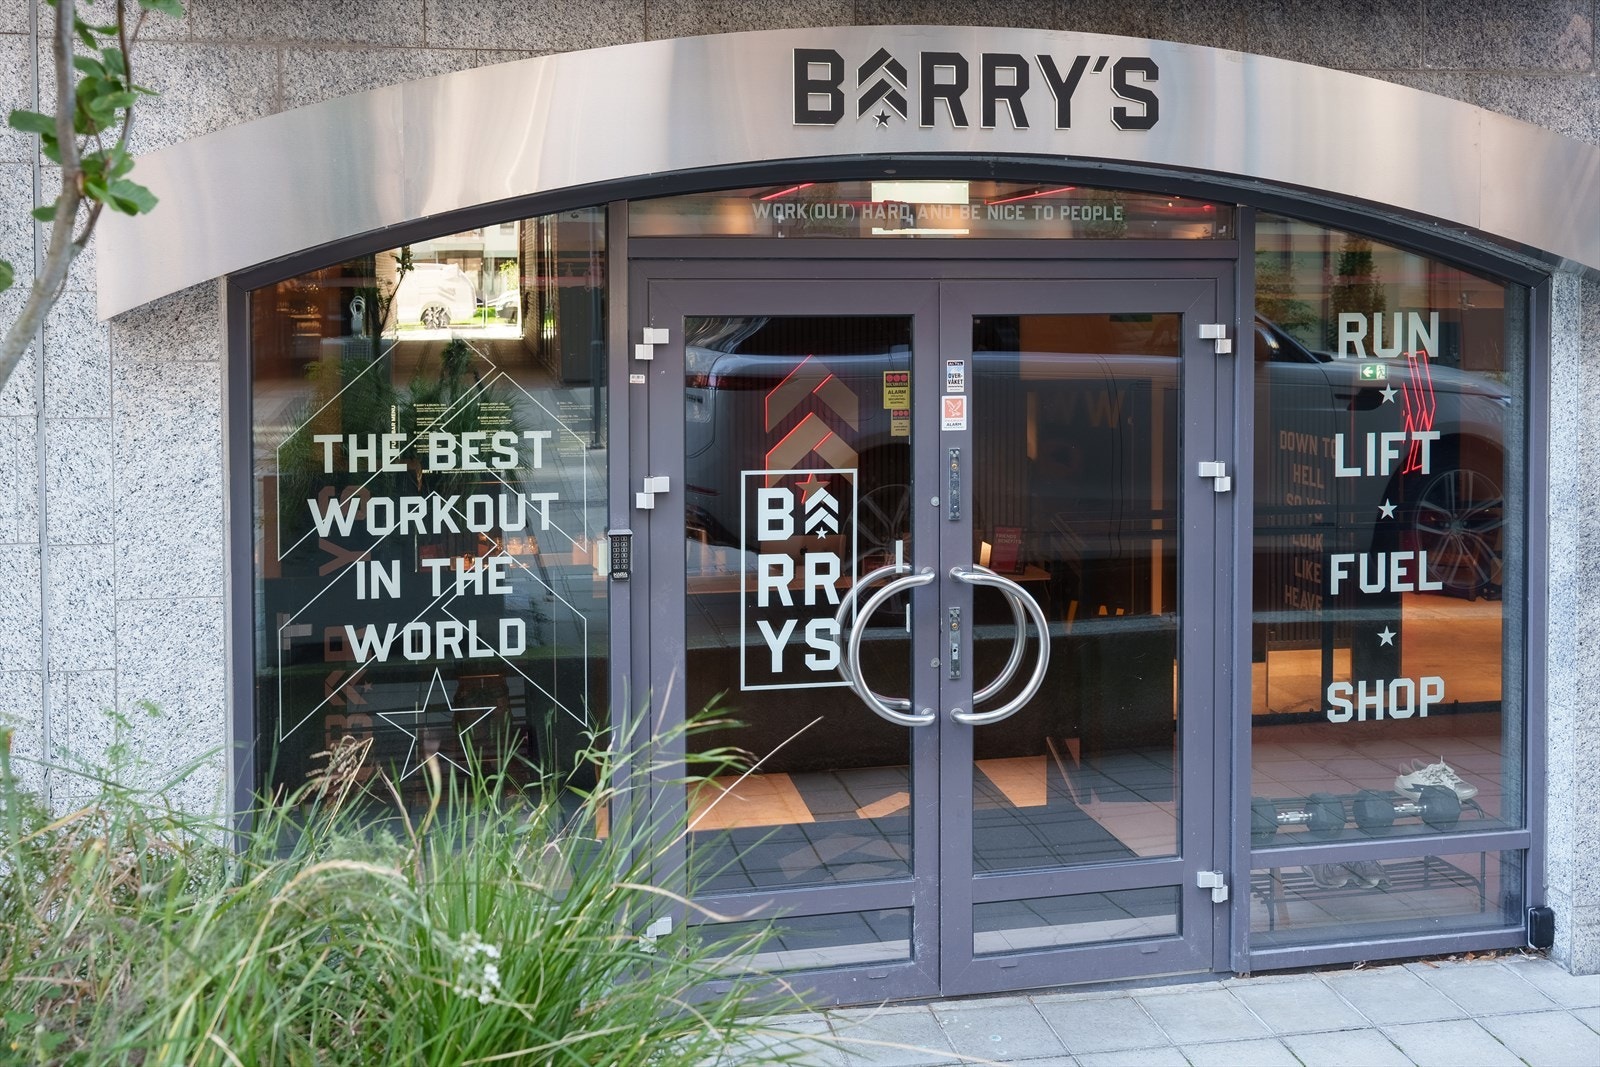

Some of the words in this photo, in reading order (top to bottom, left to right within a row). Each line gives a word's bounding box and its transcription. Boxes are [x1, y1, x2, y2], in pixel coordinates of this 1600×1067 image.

[752, 203, 855, 222] WORK(OUT)
[862, 203, 910, 220] HARD
[917, 203, 954, 220] AND
[959, 204, 981, 220] BE
[987, 204, 1025, 221] NICE
[1032, 205, 1054, 221] TO
[1060, 205, 1123, 221] PEOPLE
[1338, 311, 1440, 359] RUN
[313, 433, 407, 474] THE
[429, 430, 552, 471] BEST
[1279, 430, 1318, 456] DOWN
[1335, 430, 1440, 478] LIFT
[1293, 462, 1325, 489] HELL
[307, 492, 559, 538] WORKOUT
[356, 560, 400, 600] IN
[422, 556, 513, 597] THE
[1294, 556, 1322, 584] LIKE
[1330, 551, 1443, 596] FUEL
[344, 618, 526, 663] WORLD
[1327, 676, 1445, 723] SHOP
